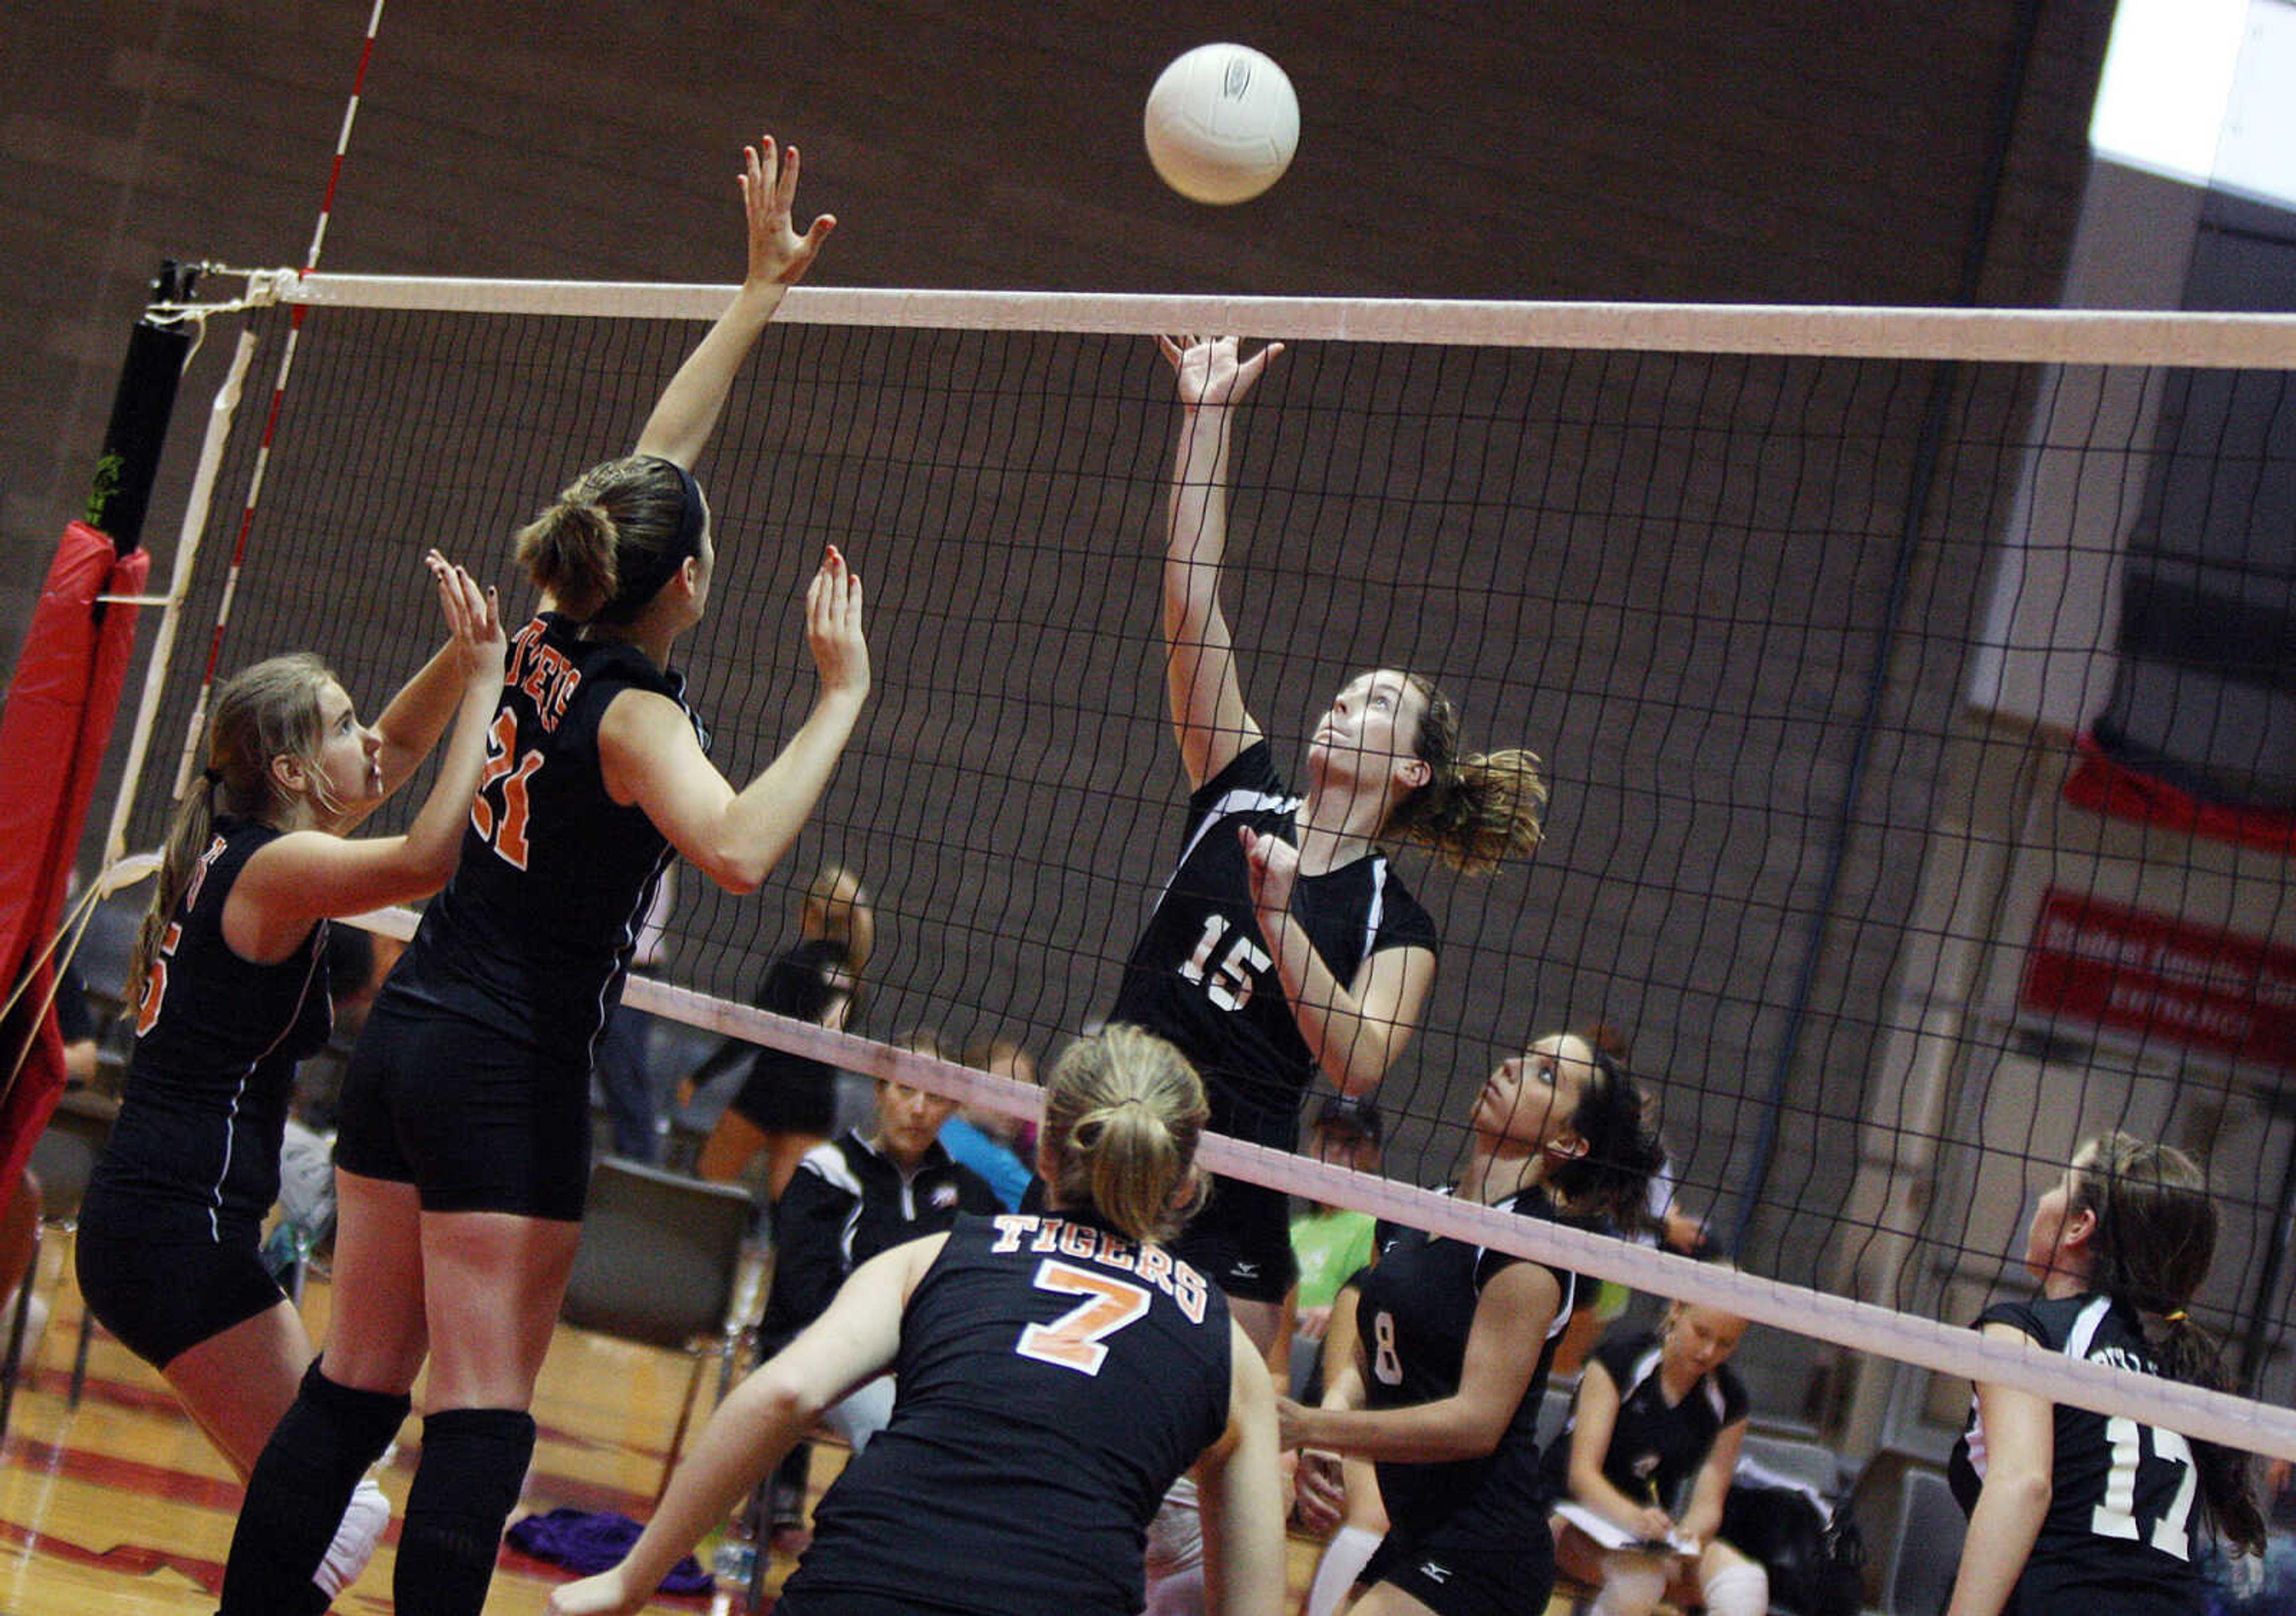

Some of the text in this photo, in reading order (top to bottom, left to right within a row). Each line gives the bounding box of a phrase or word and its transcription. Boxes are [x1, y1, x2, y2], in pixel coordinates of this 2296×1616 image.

[471, 706, 545, 871] 21
[1177, 913, 1274, 1012] 15
[991, 1214, 1208, 1324] TIGERS
[1016, 1259, 1151, 1376] 7
[1374, 1311, 1403, 1386] 8
[2092, 1415, 2198, 1562] 17
